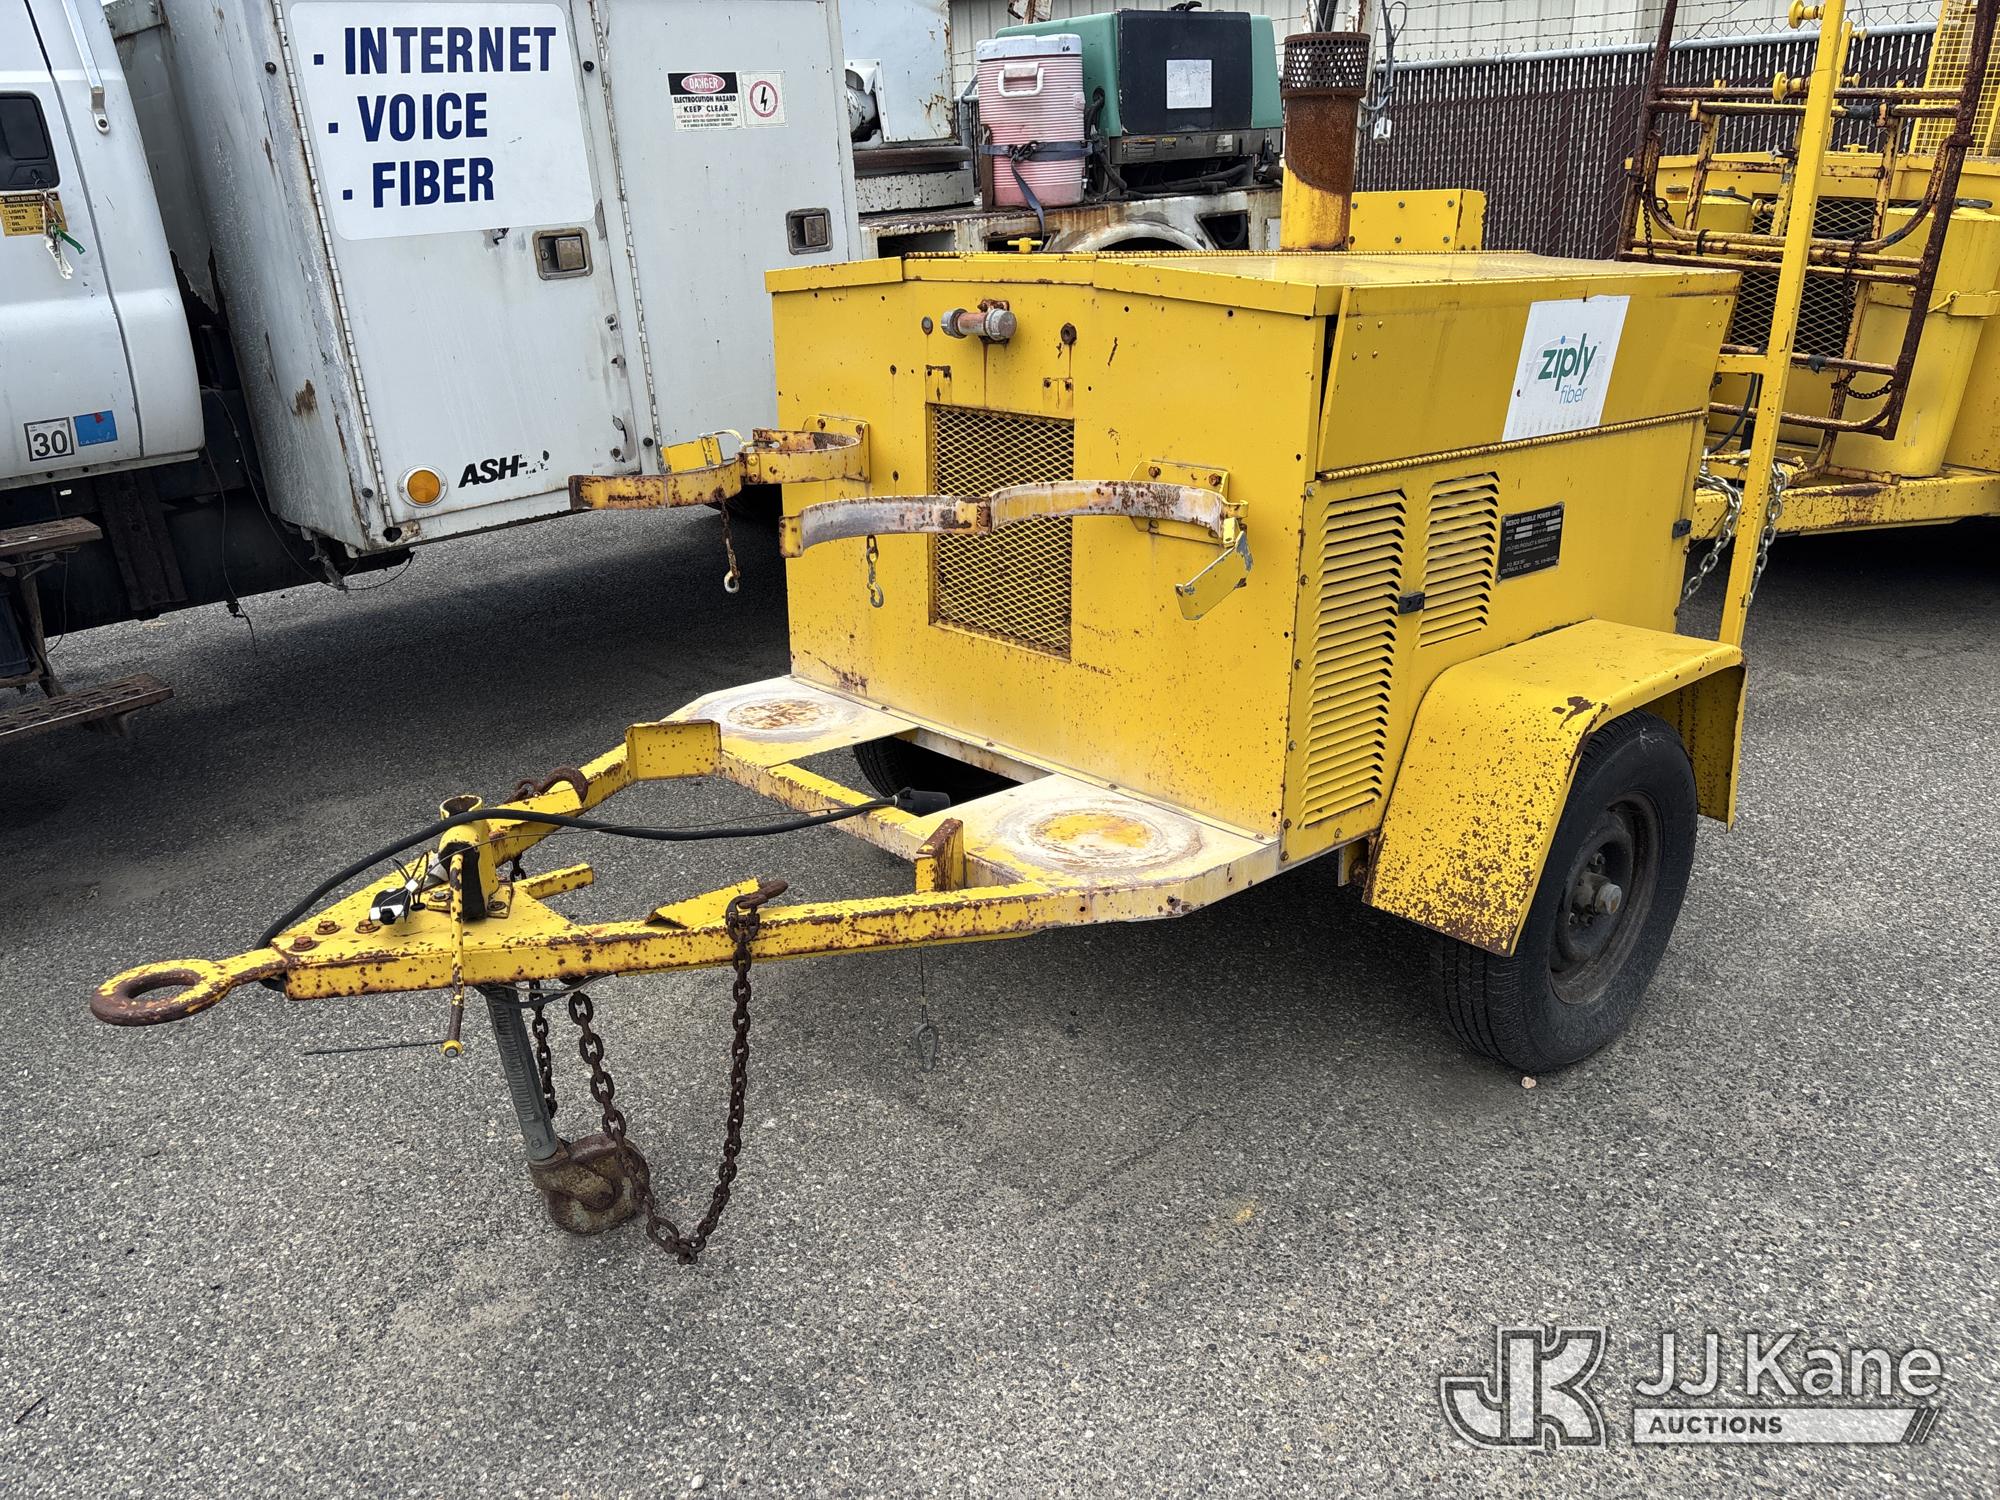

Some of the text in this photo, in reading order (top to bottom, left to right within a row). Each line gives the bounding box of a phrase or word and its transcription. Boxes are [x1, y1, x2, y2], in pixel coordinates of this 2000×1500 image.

[344, 26, 557, 75] INTERNET
[688, 77, 719, 89] DANGER
[357, 92, 488, 142] VOICE
[683, 104, 729, 113] KEEP CLEAR
[372, 157, 495, 208] FIBER
[1537, 332, 1598, 392] ziply
[1559, 384, 1588, 404] fiber
[32, 430, 68, 457] 30
